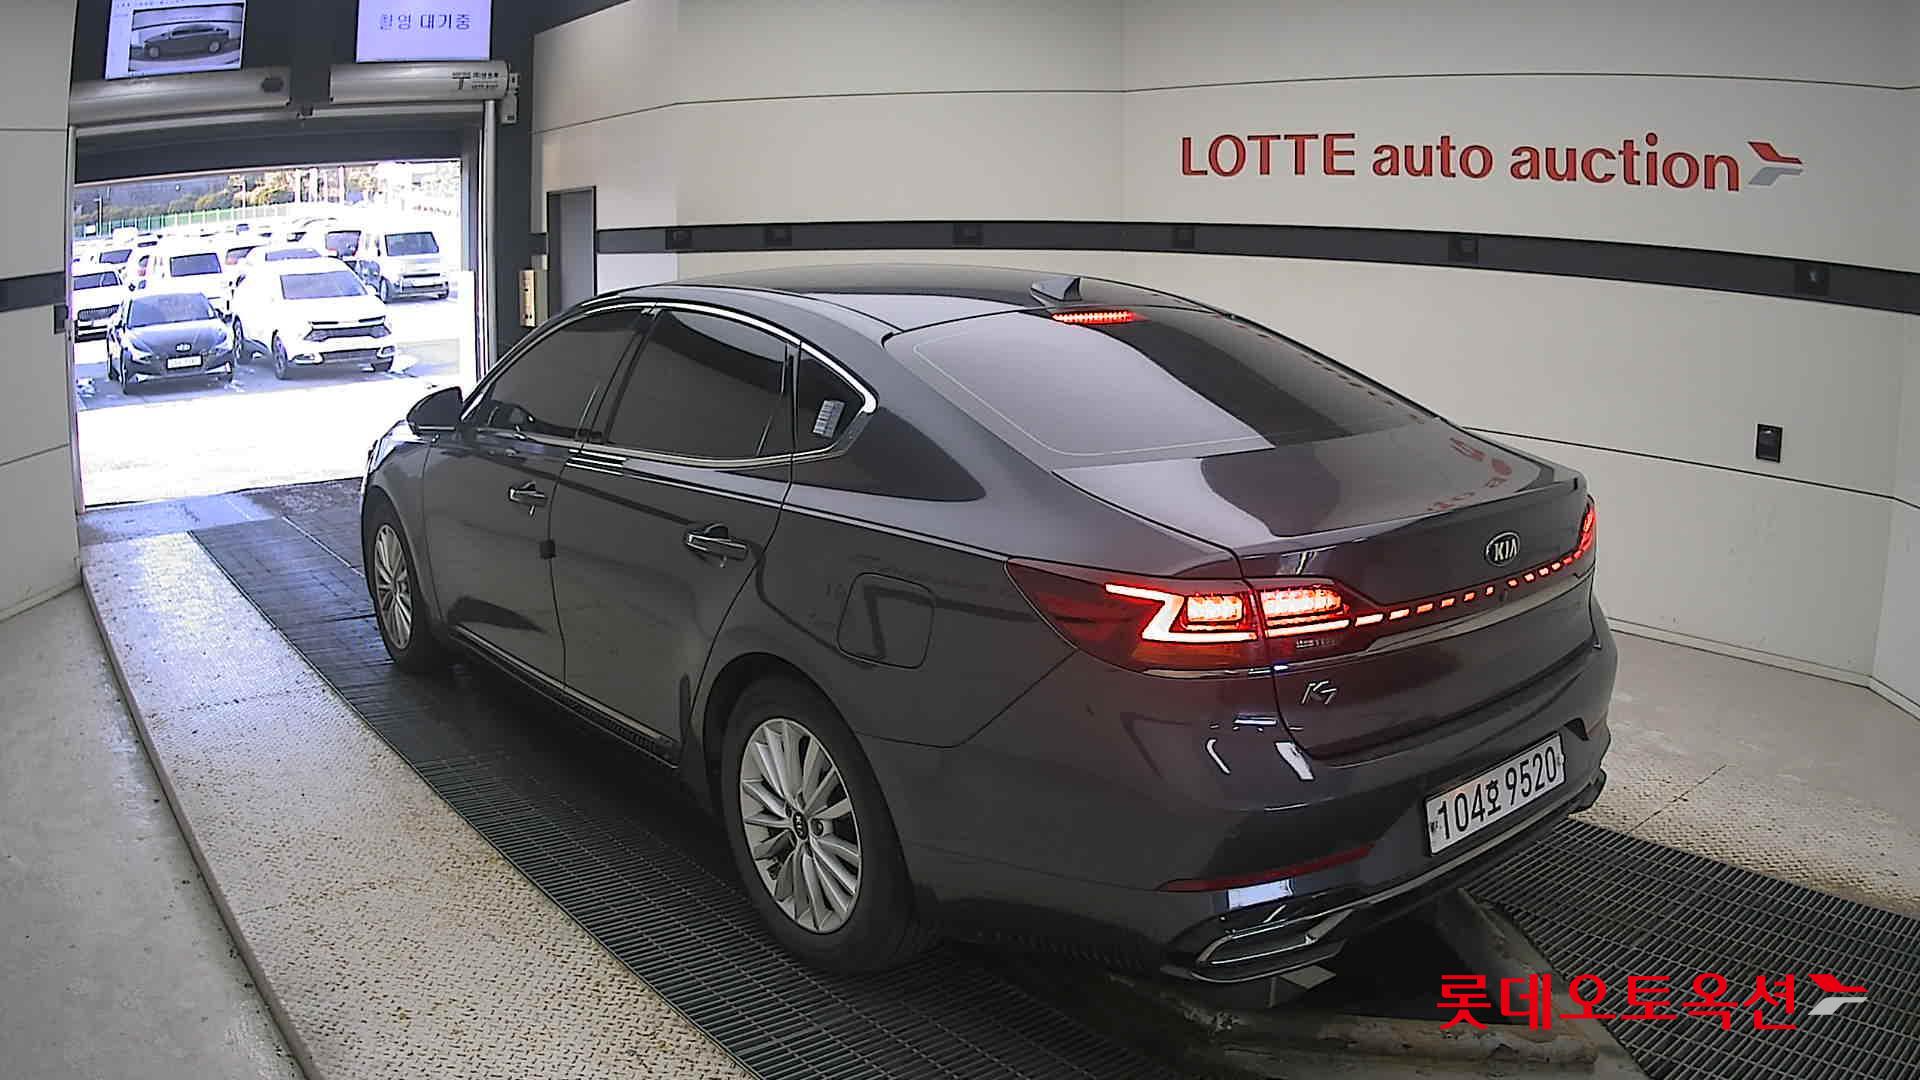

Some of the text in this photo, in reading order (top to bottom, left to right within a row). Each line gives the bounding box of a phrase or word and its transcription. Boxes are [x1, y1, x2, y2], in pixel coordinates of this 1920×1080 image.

[420, 14, 472, 30] 대기중
[1182, 132, 1741, 192] LOTTE auto auction
[1494, 538, 1518, 562] KIA
[1301, 679, 1337, 705] K7
[1437, 746, 1557, 840] 104호 9520
